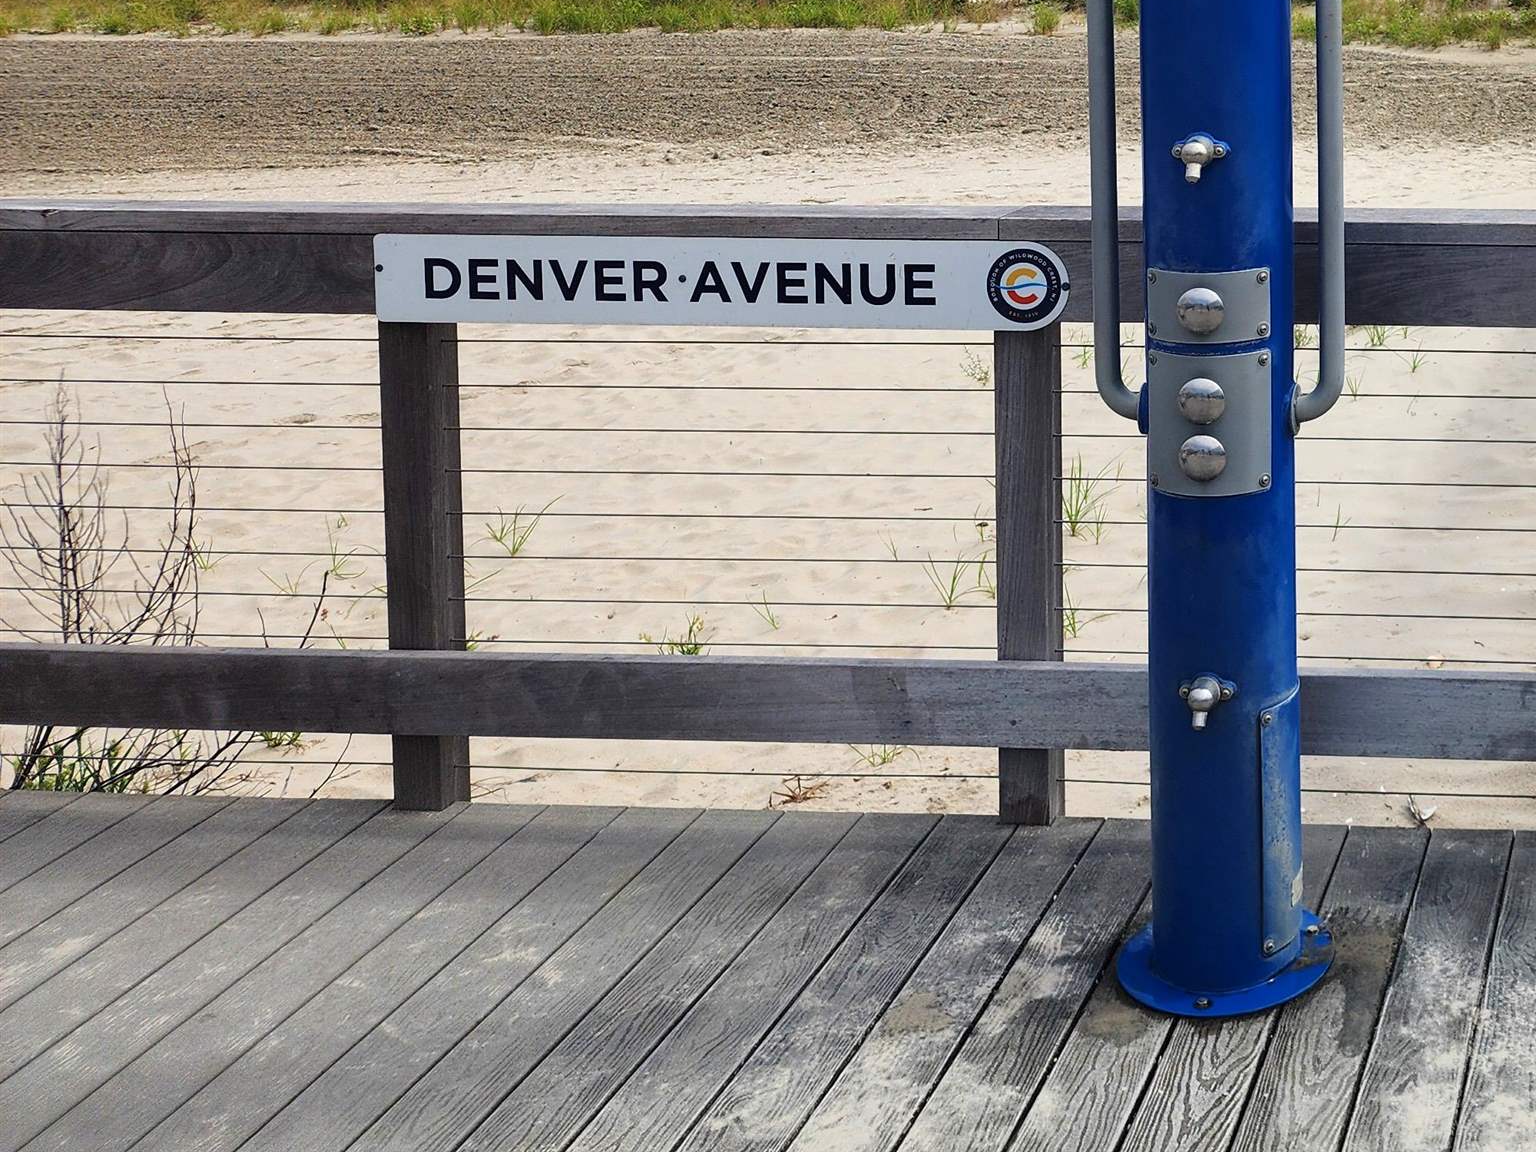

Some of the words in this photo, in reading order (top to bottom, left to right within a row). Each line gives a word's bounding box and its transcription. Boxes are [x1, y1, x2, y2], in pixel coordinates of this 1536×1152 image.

[1009, 253, 1047, 267] WILDWOOD
[423, 257, 669, 303] DENVER
[689, 260, 937, 306] AVENUE
